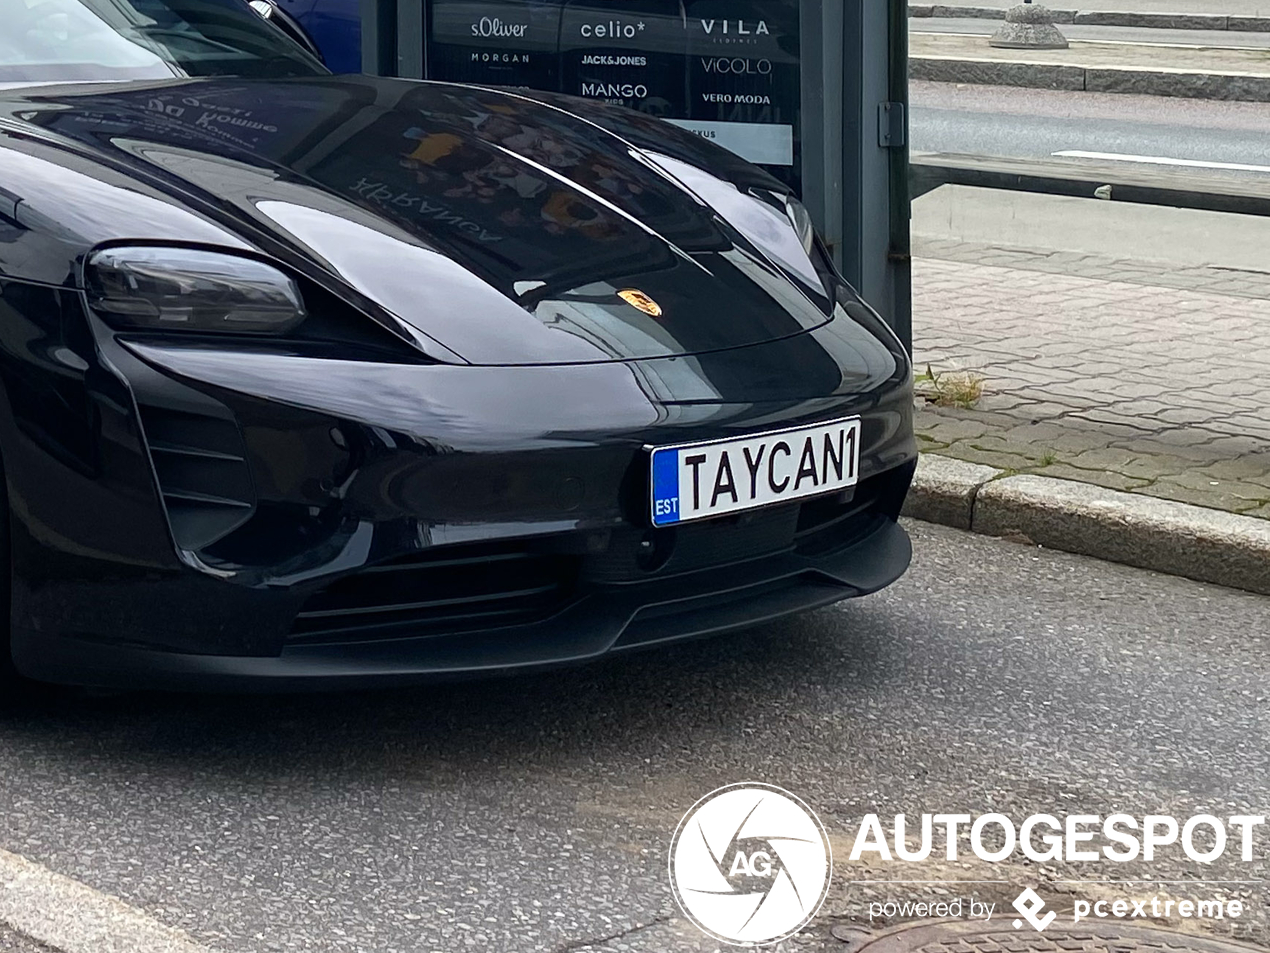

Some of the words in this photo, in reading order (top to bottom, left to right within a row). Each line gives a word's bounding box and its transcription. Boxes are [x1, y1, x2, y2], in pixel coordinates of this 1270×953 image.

[471, 16, 528, 38] s.Oliver
[701, 19, 770, 35] VILA
[471, 53, 530, 64] MORGAN
[581, 55, 647, 66] JACK&JONES
[582, 82, 648, 98] MANGO
[702, 93, 732, 103] VERO
[734, 94, 771, 105] MODA
[656, 498, 678, 516] EST
[685, 426, 856, 510] TAYCAN1
